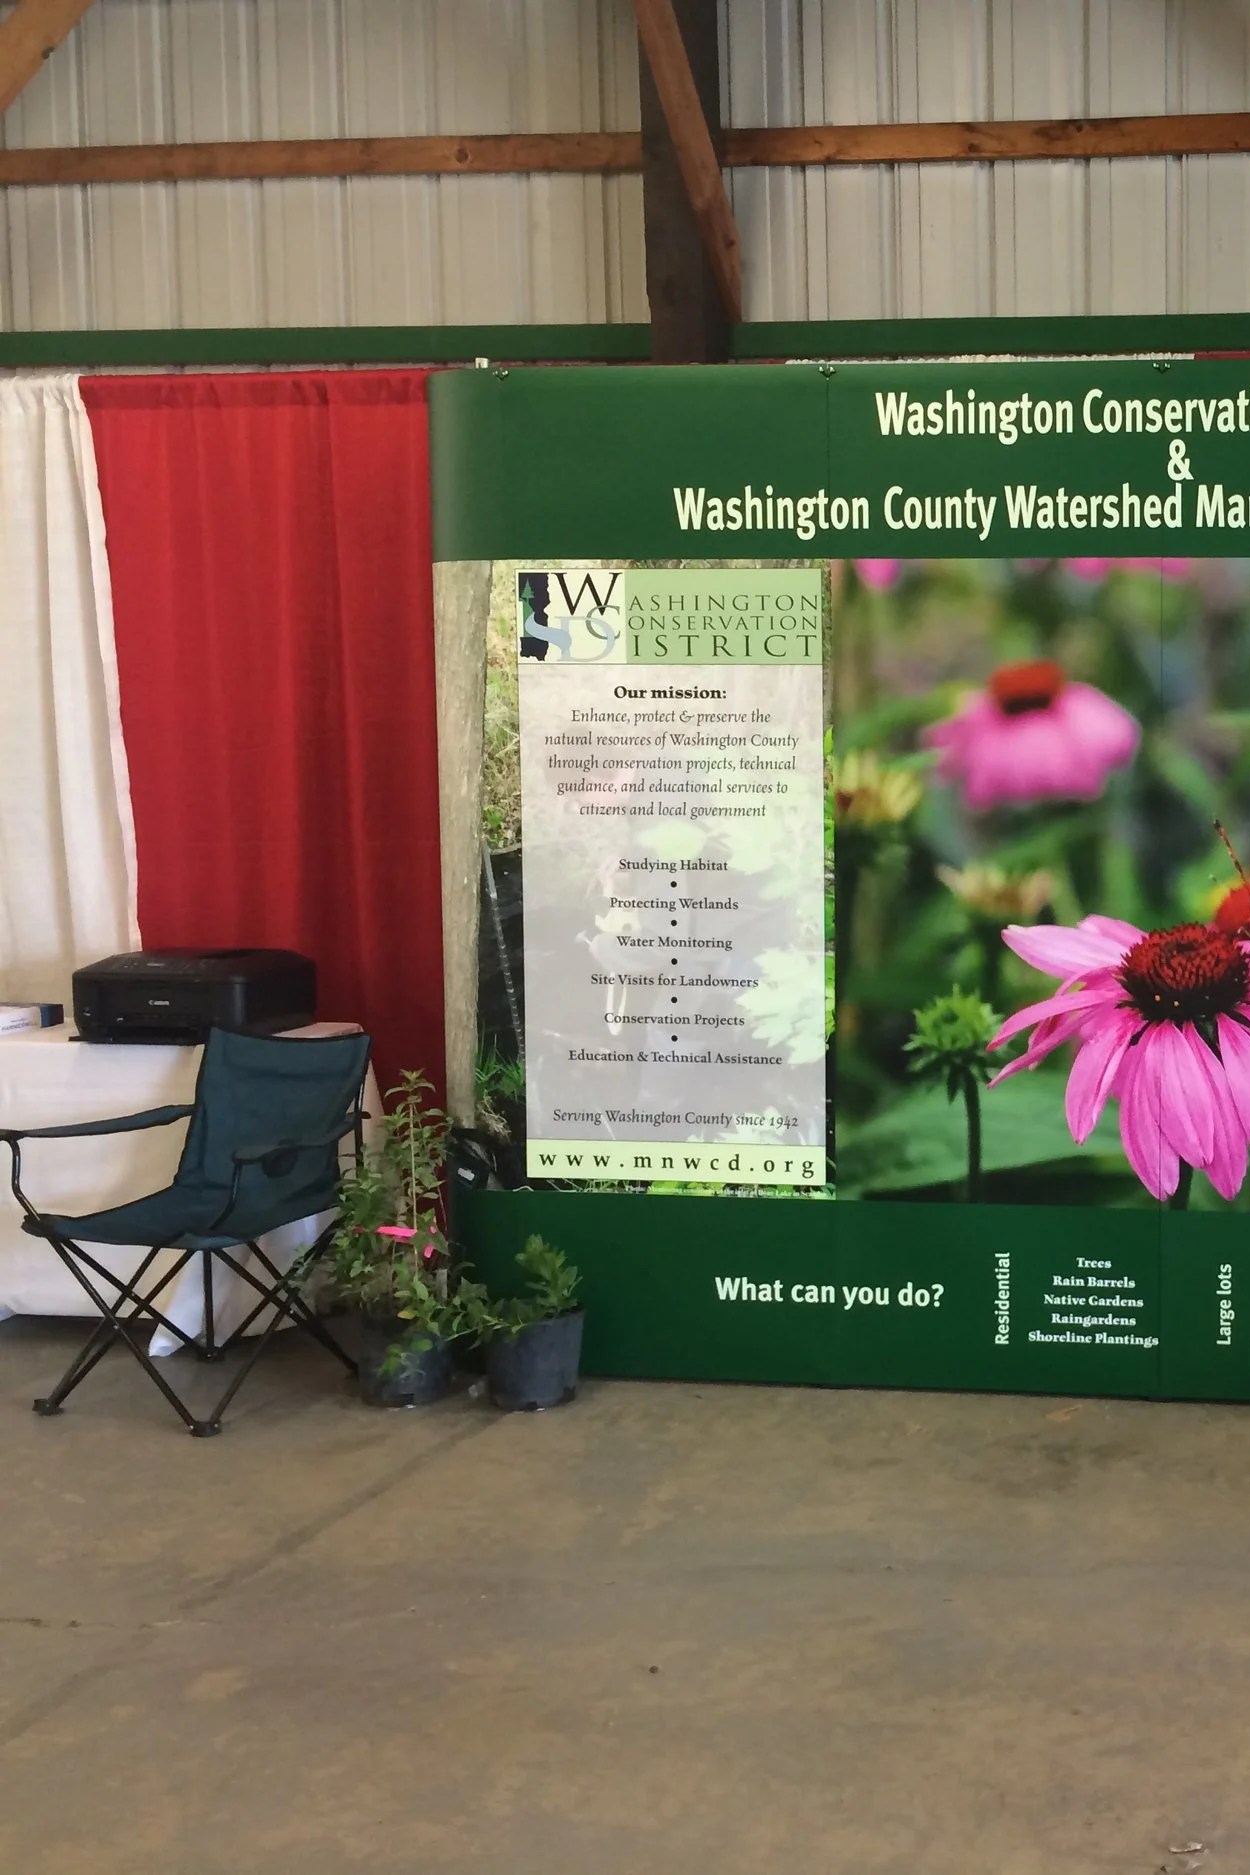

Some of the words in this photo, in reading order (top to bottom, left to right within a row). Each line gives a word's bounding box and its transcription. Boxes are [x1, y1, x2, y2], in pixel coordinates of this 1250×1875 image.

[875, 389, 1074, 445] Washington
[1167, 439, 1194, 481] &
[673, 485, 869, 540] Washington
[883, 486, 997, 541] County
[1004, 482, 1182, 530] Watershed
[613, 686, 647, 700] Our
[650, 686, 727, 700] mission:
[571, 709, 630, 724] Enhance,
[633, 711, 675, 726] protect
[679, 711, 695, 723] &
[696, 711, 747, 726] preserve
[751, 710, 771, 723] the
[545, 733, 592, 745] natural
[597, 735, 651, 746] resources
[655, 733, 666, 749] of
[670, 733, 747, 750] Washington
[751, 734, 799, 749] County
[548, 756, 598, 772] through
[602, 758, 682, 770] conservation
[686, 757, 736, 773] projects,
[740, 757, 796, 770] technical
[579, 804, 626, 816] citizens
[630, 804, 654, 816] and
[658, 803, 686, 816] local
[690, 804, 766, 820] government
[619, 859, 677, 872] Studying
[680, 859, 728, 871] Habitat
[610, 897, 676, 911] Protecting
[679, 898, 739, 910] Wetlands
[617, 936, 655, 948] Water
[658, 936, 732, 950] Monitoring
[591, 974, 615, 986] Site
[618, 974, 654, 987] Visits
[658, 974, 676, 987] for
[680, 975, 759, 988] Landowners
[604, 1013, 690, 1025] Conservation
[694, 1014, 745, 1029] Projects
[568, 1050, 634, 1063] Education
[637, 1052, 648, 1063] &
[651, 1051, 711, 1064] Technical
[715, 1053, 783, 1066] Assistance
[553, 1109, 601, 1125] Serving
[604, 1109, 681, 1127] Washington
[685, 1111, 733, 1127] County
[735, 1113, 766, 1127] since
[769, 1116, 799, 1131] 1942
[1076, 1257, 1112, 1269] Trees
[1052, 1275, 1085, 1287] Rain
[1087, 1276, 1135, 1289] Barrels
[1216, 1263, 1232, 1295] lots
[715, 1276, 783, 1302] What
[791, 1283, 835, 1303] can
[842, 1285, 890, 1310] you
[897, 1282, 944, 1307] do?
[994, 1252, 1010, 1345] Residential
[1044, 1294, 1086, 1306] Native
[1088, 1295, 1144, 1308] Gardens
[1051, 1313, 1136, 1327] Raingardens
[1216, 1300, 1235, 1346] Large
[1028, 1330, 1092, 1344] Shoreline
[1094, 1332, 1159, 1348] Plantings
